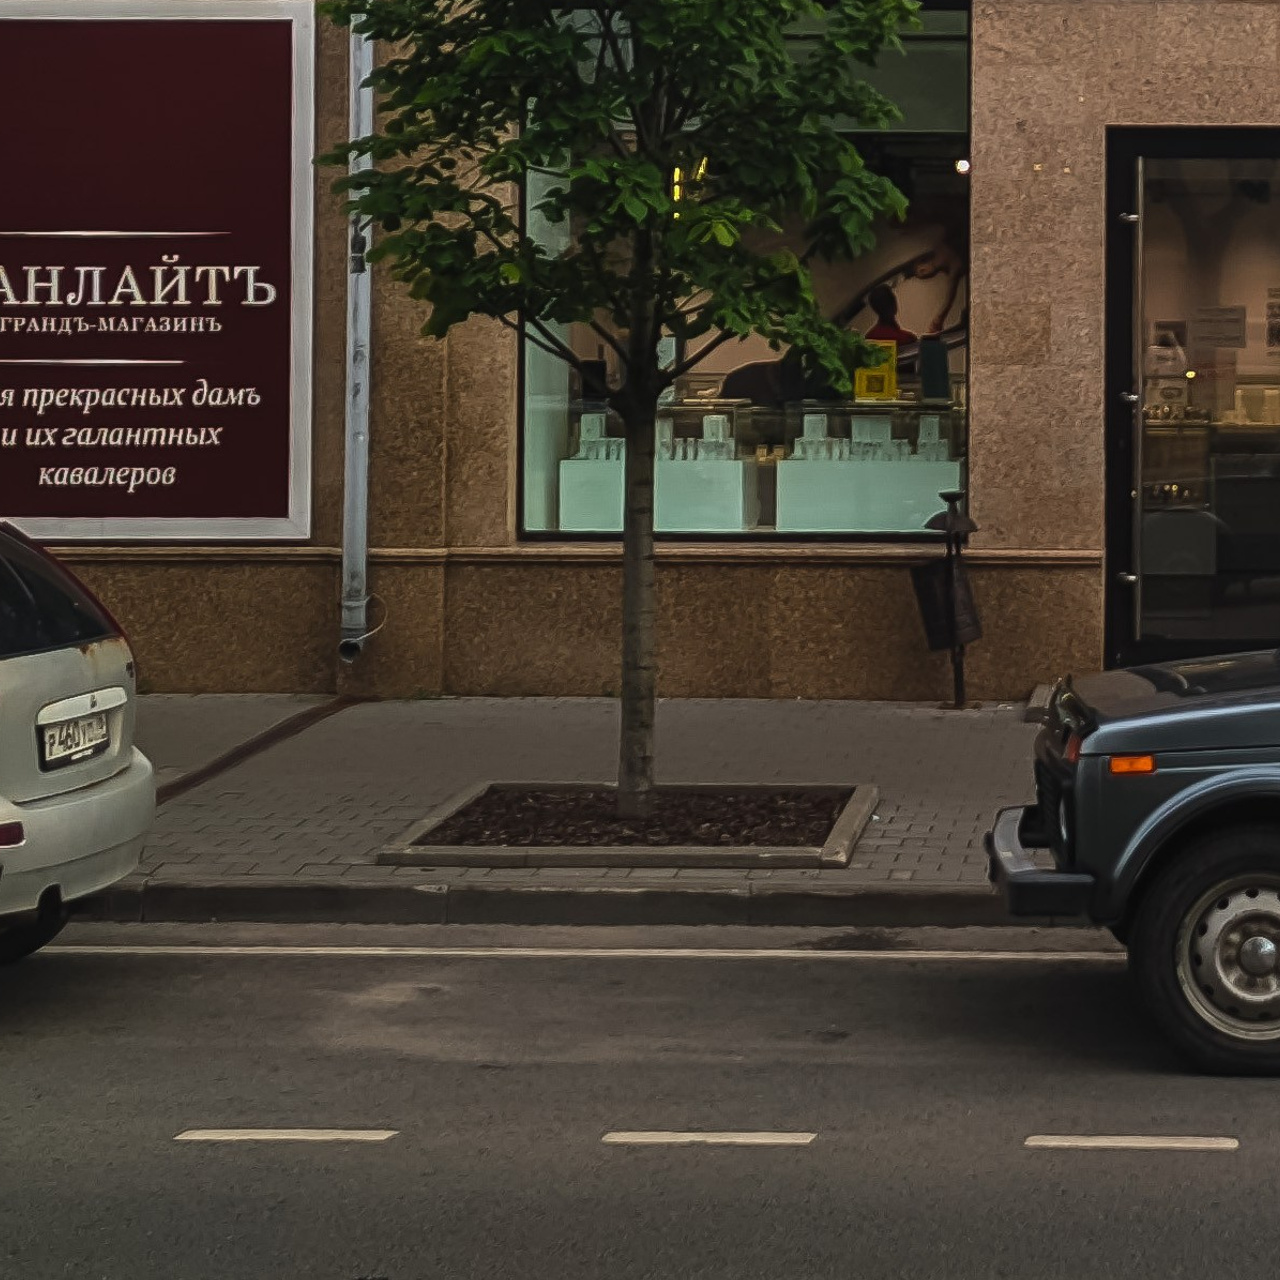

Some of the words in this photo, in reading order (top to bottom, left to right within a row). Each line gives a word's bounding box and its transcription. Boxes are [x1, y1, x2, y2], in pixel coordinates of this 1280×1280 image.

[22, 388, 187, 416] прекрасных
[192, 378, 262, 407] дамъ
[2, 427, 18, 446] и
[26, 427, 58, 446] их
[62, 426, 224, 446] галантных
[38, 466, 177, 493] кавалеров
